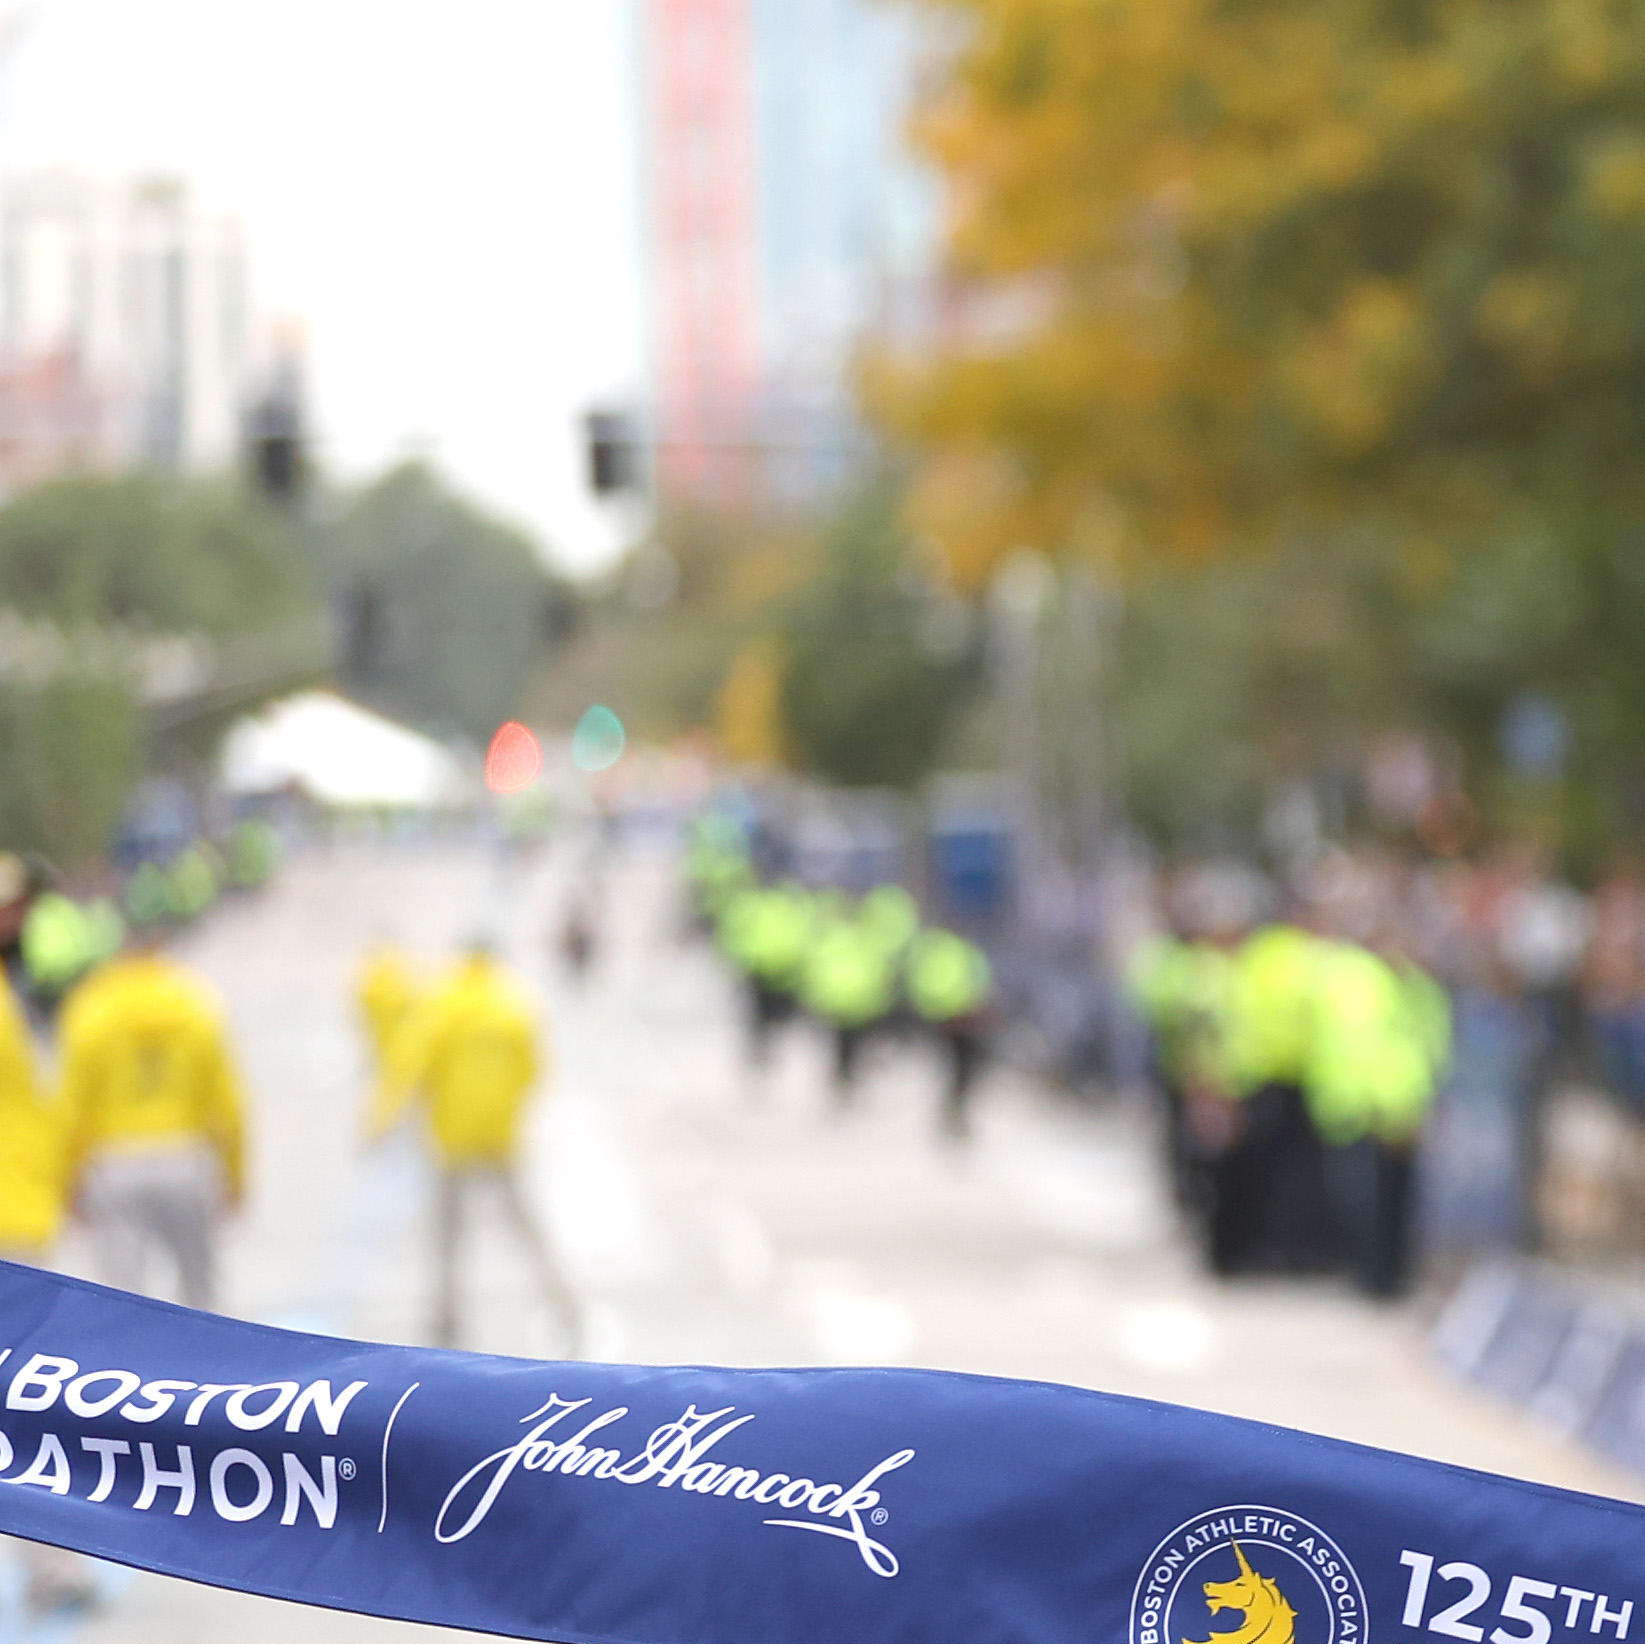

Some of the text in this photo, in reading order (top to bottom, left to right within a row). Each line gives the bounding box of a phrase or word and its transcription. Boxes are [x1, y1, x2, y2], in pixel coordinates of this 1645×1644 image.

[6, 1353, 369, 1435] BOSTON
[434, 1392, 915, 1578] John Hancock
[1140, 1548, 1186, 1644] BOSTON
[1184, 1515, 1297, 1553] ATHLETIC
